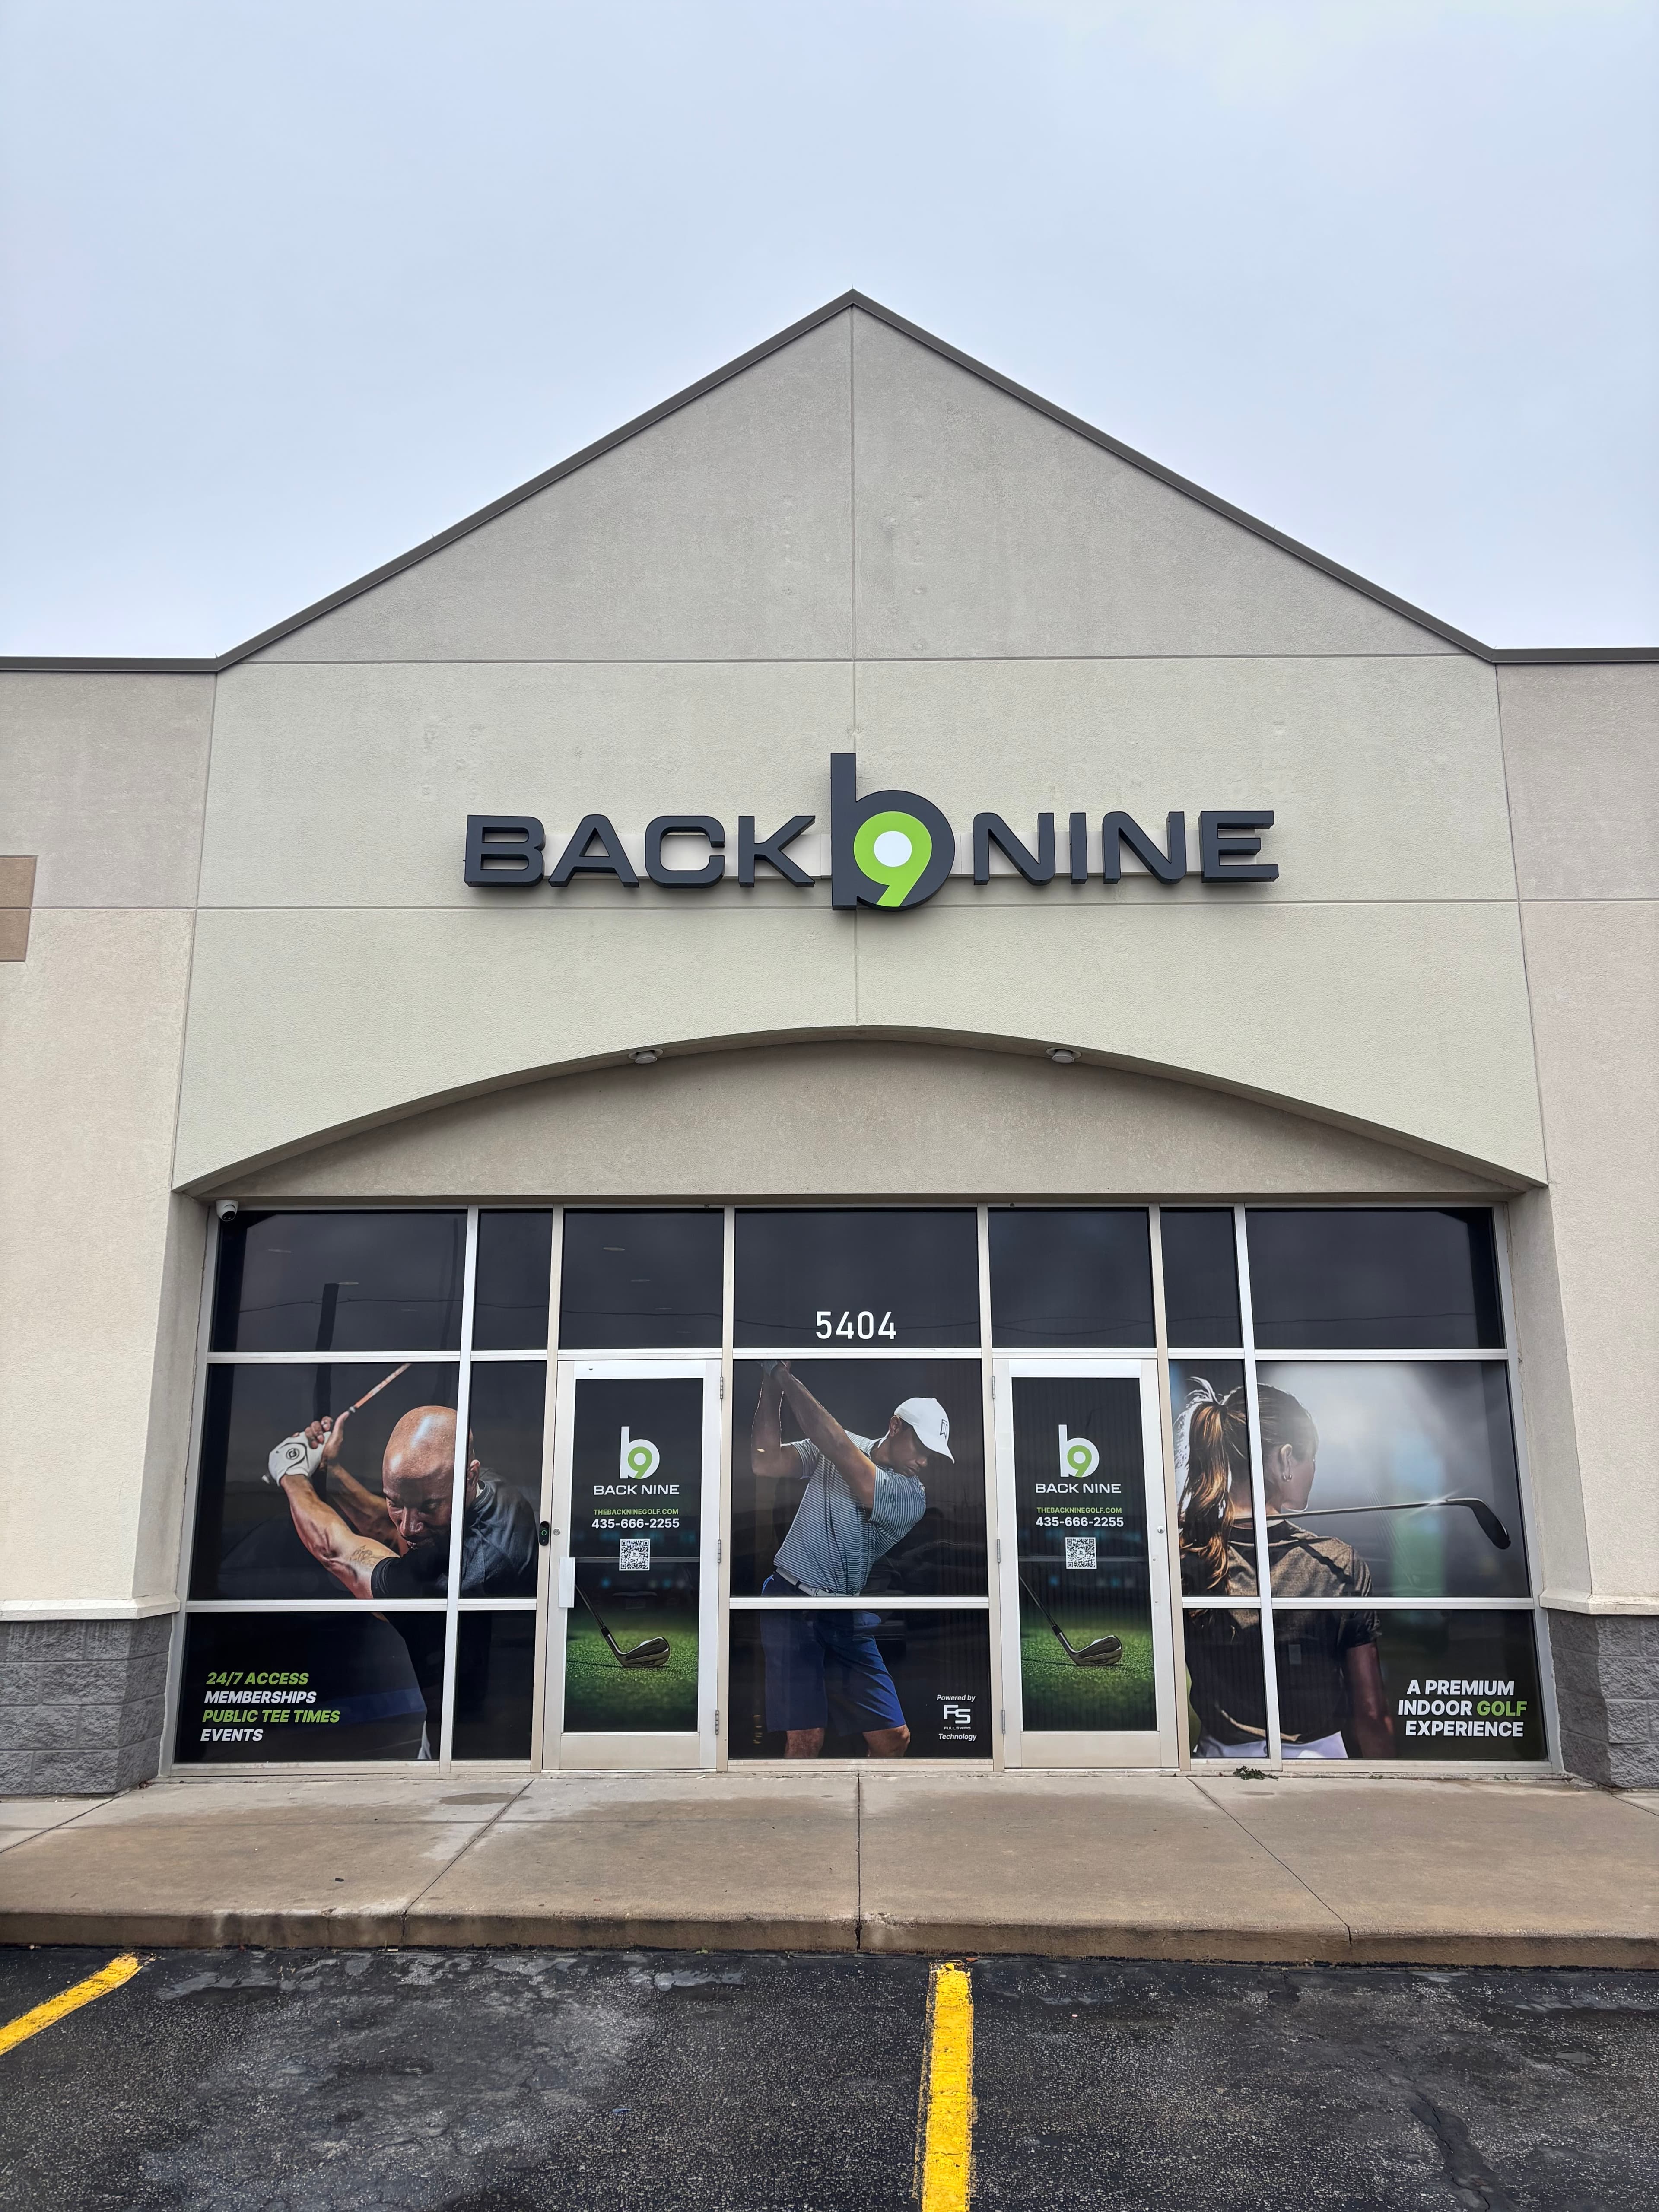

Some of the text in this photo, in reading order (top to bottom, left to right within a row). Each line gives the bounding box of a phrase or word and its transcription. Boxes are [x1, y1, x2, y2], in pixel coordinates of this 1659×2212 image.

[464, 814, 816, 888] BACK
[973, 810, 1279, 886] NINE
[816, 1311, 896, 1339] 5404
[593, 1484, 680, 1495] BACK NINE
[1035, 1483, 1122, 1494] BACK NINE
[591, 1518, 680, 1529] 435-666-2255
[1036, 1516, 1124, 1527] 435-666-2255
[206, 1672, 309, 1686] 24/7 ACCESS
[1406, 1679, 1514, 1696] A PREMIUM
[204, 1691, 317, 1704] MEMBERSHIPS
[1398, 1700, 1528, 1716] INDOOR GOLF
[202, 1710, 340, 1723] PUBLIC TEE TIMES
[1405, 1720, 1524, 1737] EXPERIENCE
[200, 1729, 264, 1742] EVENTS
